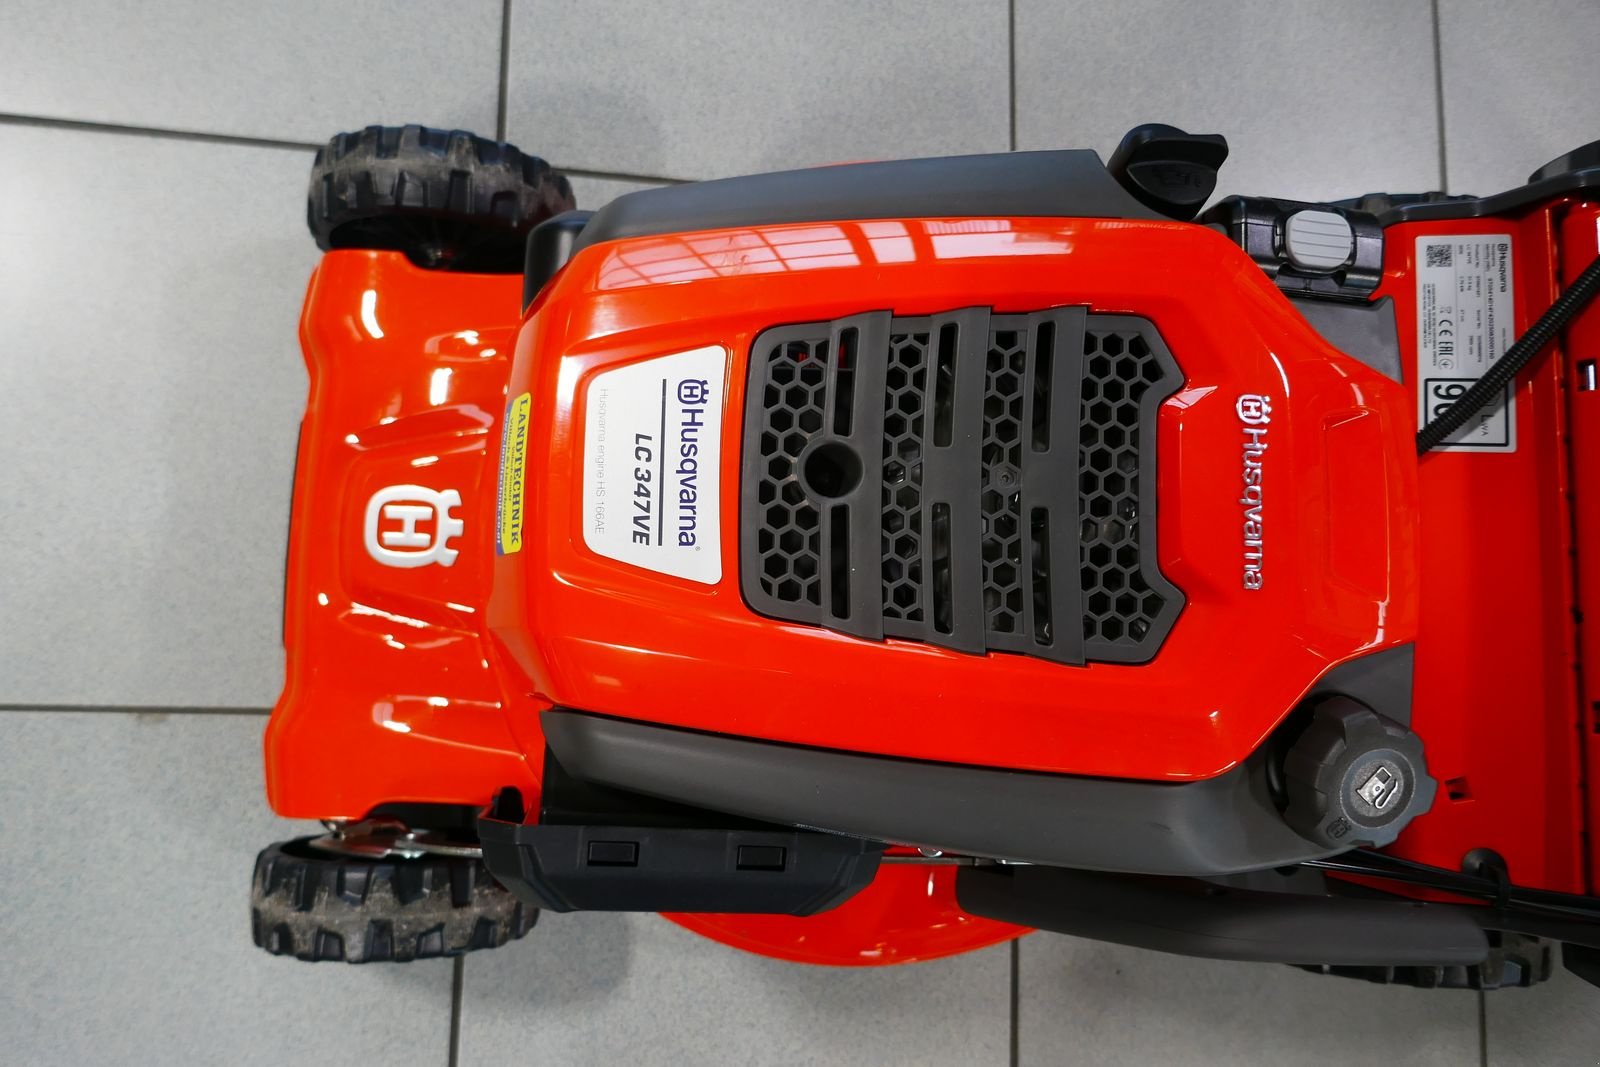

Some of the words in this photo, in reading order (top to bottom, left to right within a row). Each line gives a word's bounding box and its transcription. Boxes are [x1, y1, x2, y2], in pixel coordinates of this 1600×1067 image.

[1498, 252, 1507, 293] Husqvarna
[596, 388, 608, 442] Husqvarna
[511, 398, 528, 545] LANDTECHNIK
[594, 444, 606, 478] engine
[634, 434, 652, 462] LC
[596, 481, 606, 497] HS
[676, 408, 704, 547] Husqvarna
[594, 501, 604, 534] 166AE
[632, 468, 650, 546] 347VE
[1238, 427, 1268, 590] Husqvarna
